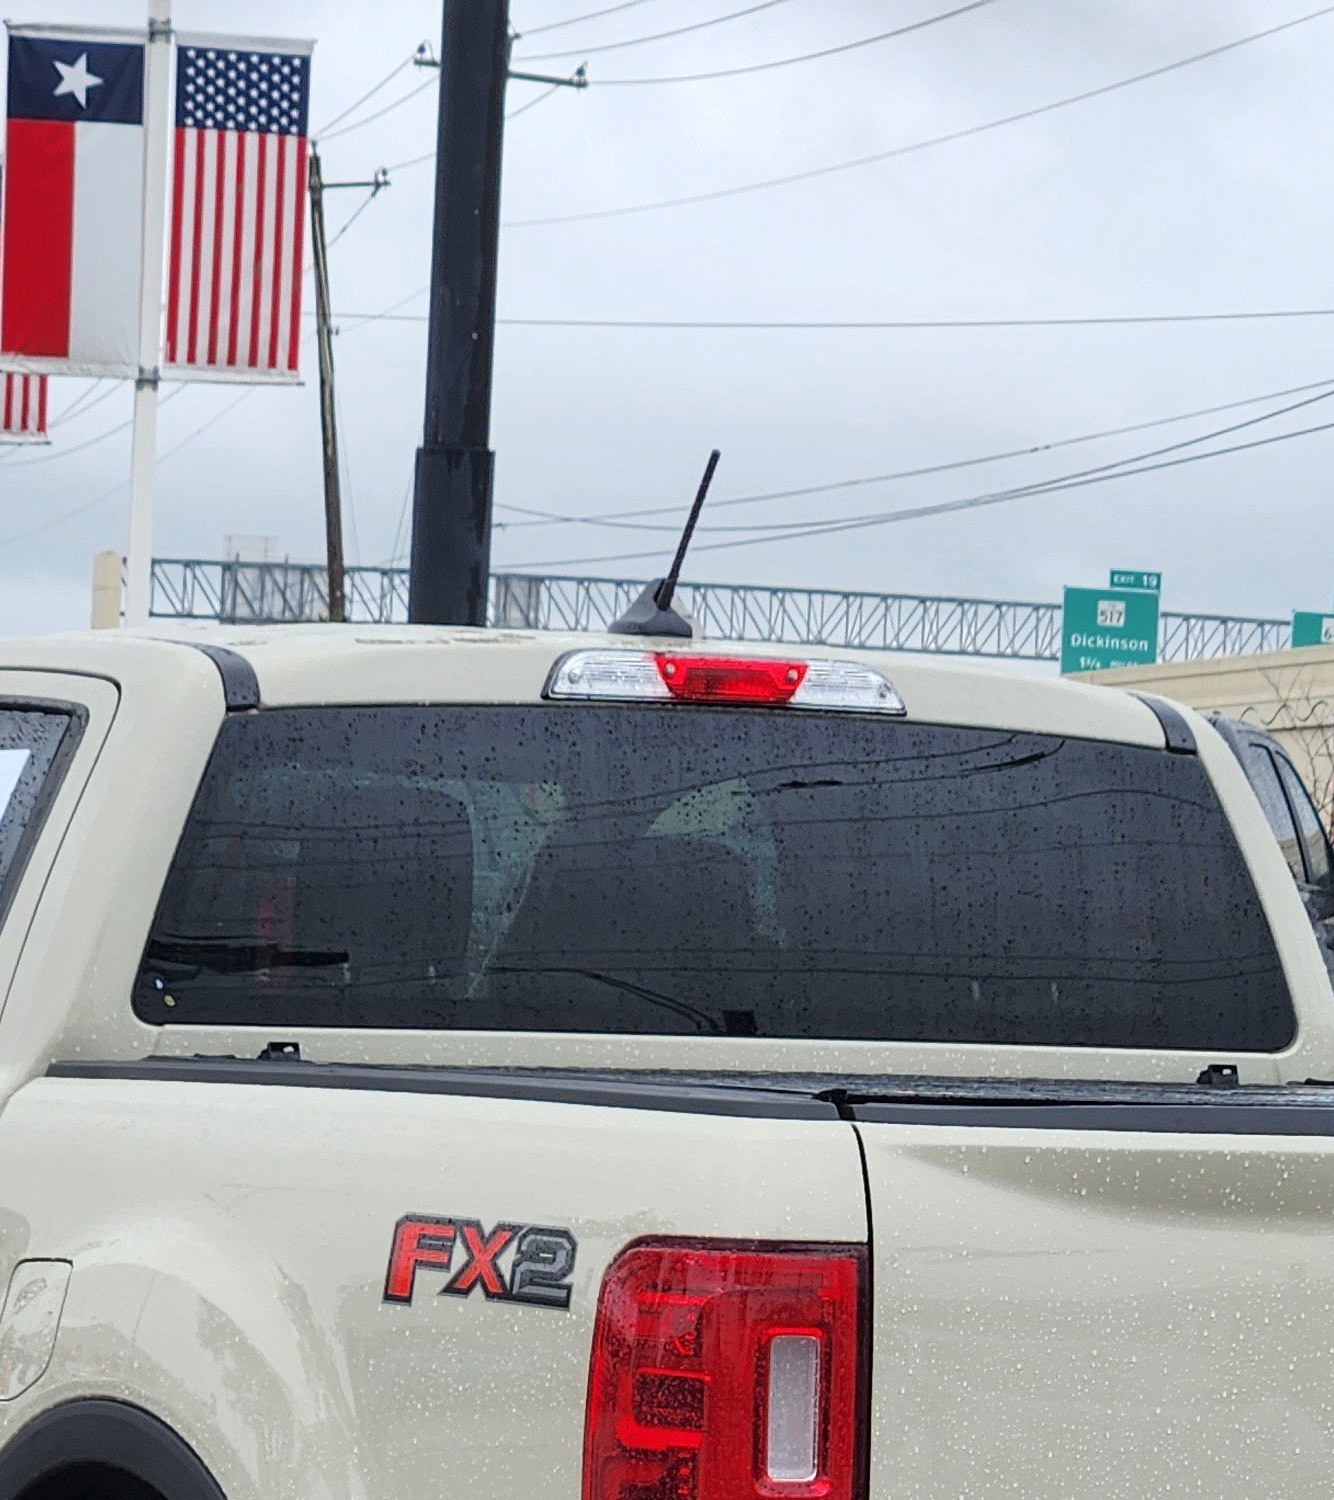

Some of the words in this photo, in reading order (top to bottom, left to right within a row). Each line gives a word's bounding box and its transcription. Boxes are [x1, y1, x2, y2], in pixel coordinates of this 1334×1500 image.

[1113, 574, 1136, 585] EXIT
[1142, 574, 1158, 588] 19
[1099, 609, 1124, 624] 517
[1070, 632, 1149, 652] Dickinson
[381, 1211, 579, 1312] FX2
